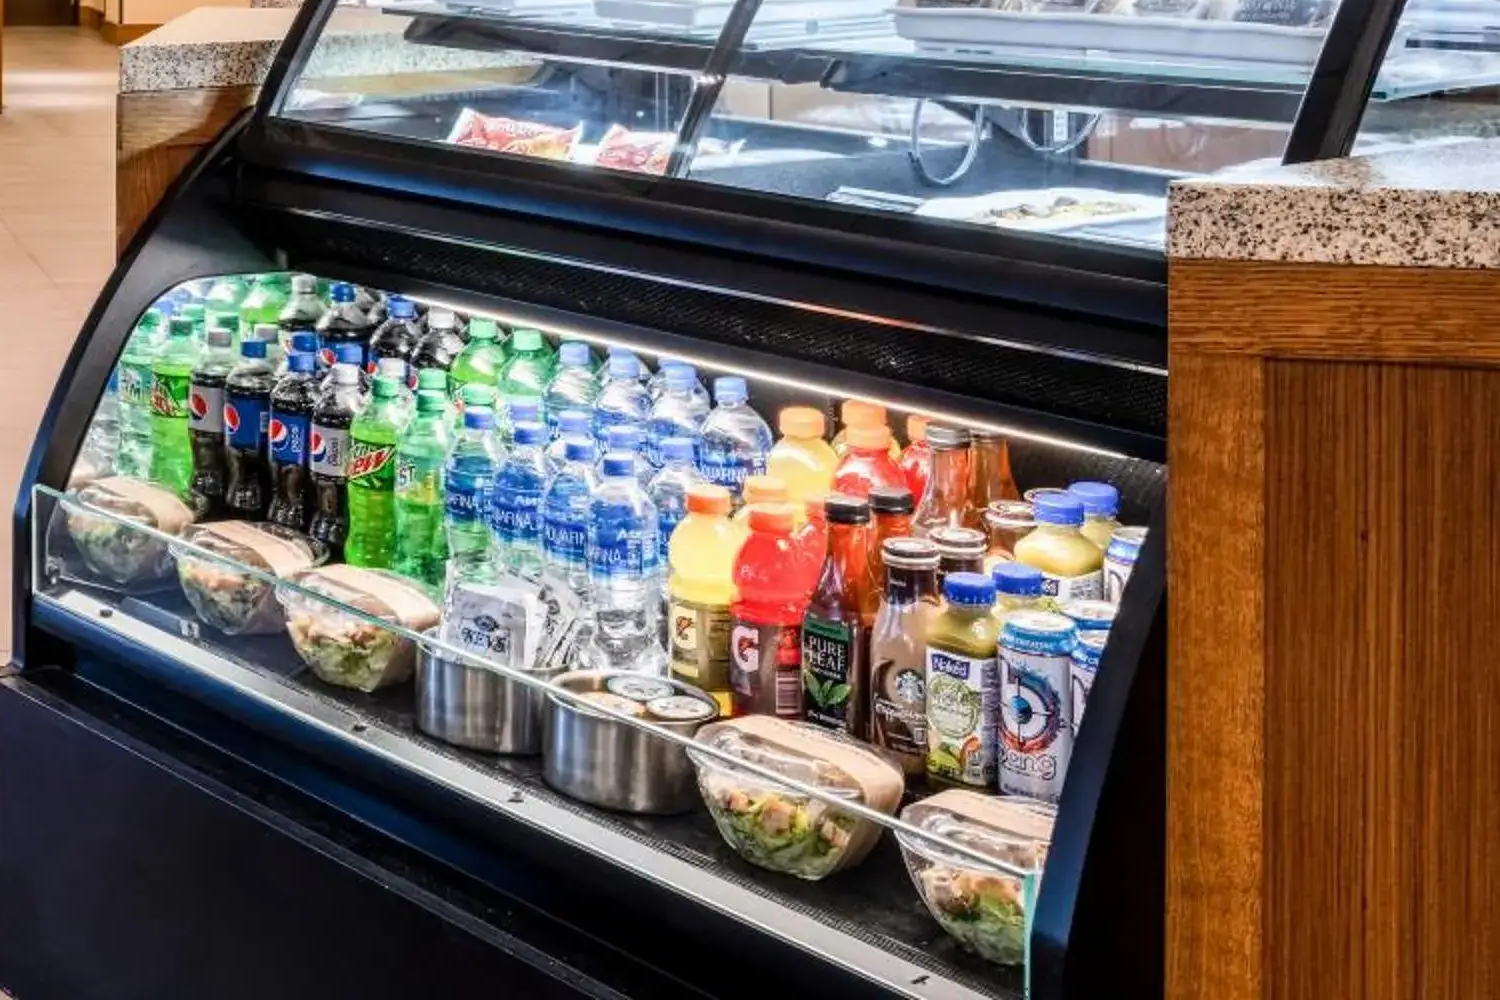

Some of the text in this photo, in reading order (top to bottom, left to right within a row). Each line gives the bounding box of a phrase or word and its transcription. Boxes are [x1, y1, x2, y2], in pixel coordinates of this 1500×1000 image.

[732, 624, 759, 673] G
[808, 635, 845, 657] PURE
[809, 648, 846, 672] LEAF
